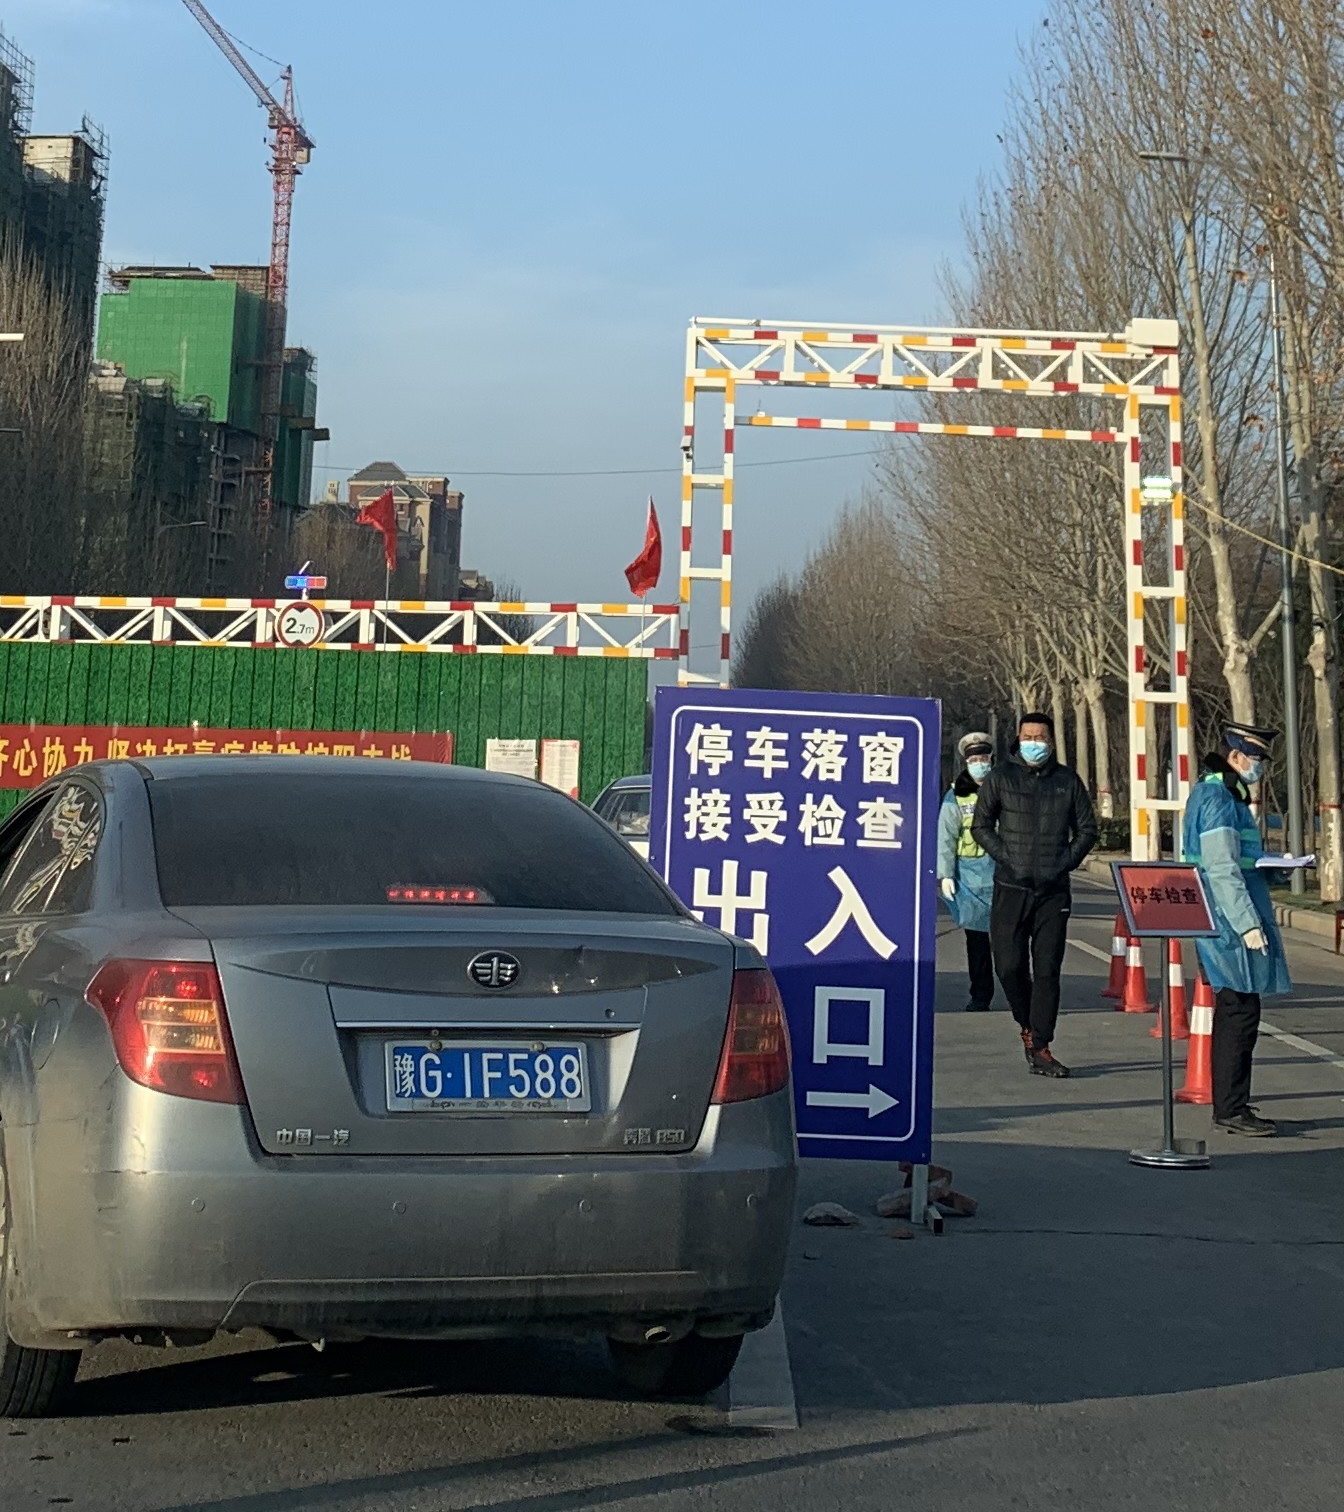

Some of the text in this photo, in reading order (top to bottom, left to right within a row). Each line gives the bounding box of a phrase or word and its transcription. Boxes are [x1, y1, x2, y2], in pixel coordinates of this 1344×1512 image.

[684, 722, 905, 785] 停车落窗
[684, 788, 903, 849] 接受检查
[1131, 886, 1199, 904] 停车检查
[276, 1128, 350, 1146] 中国一汽
